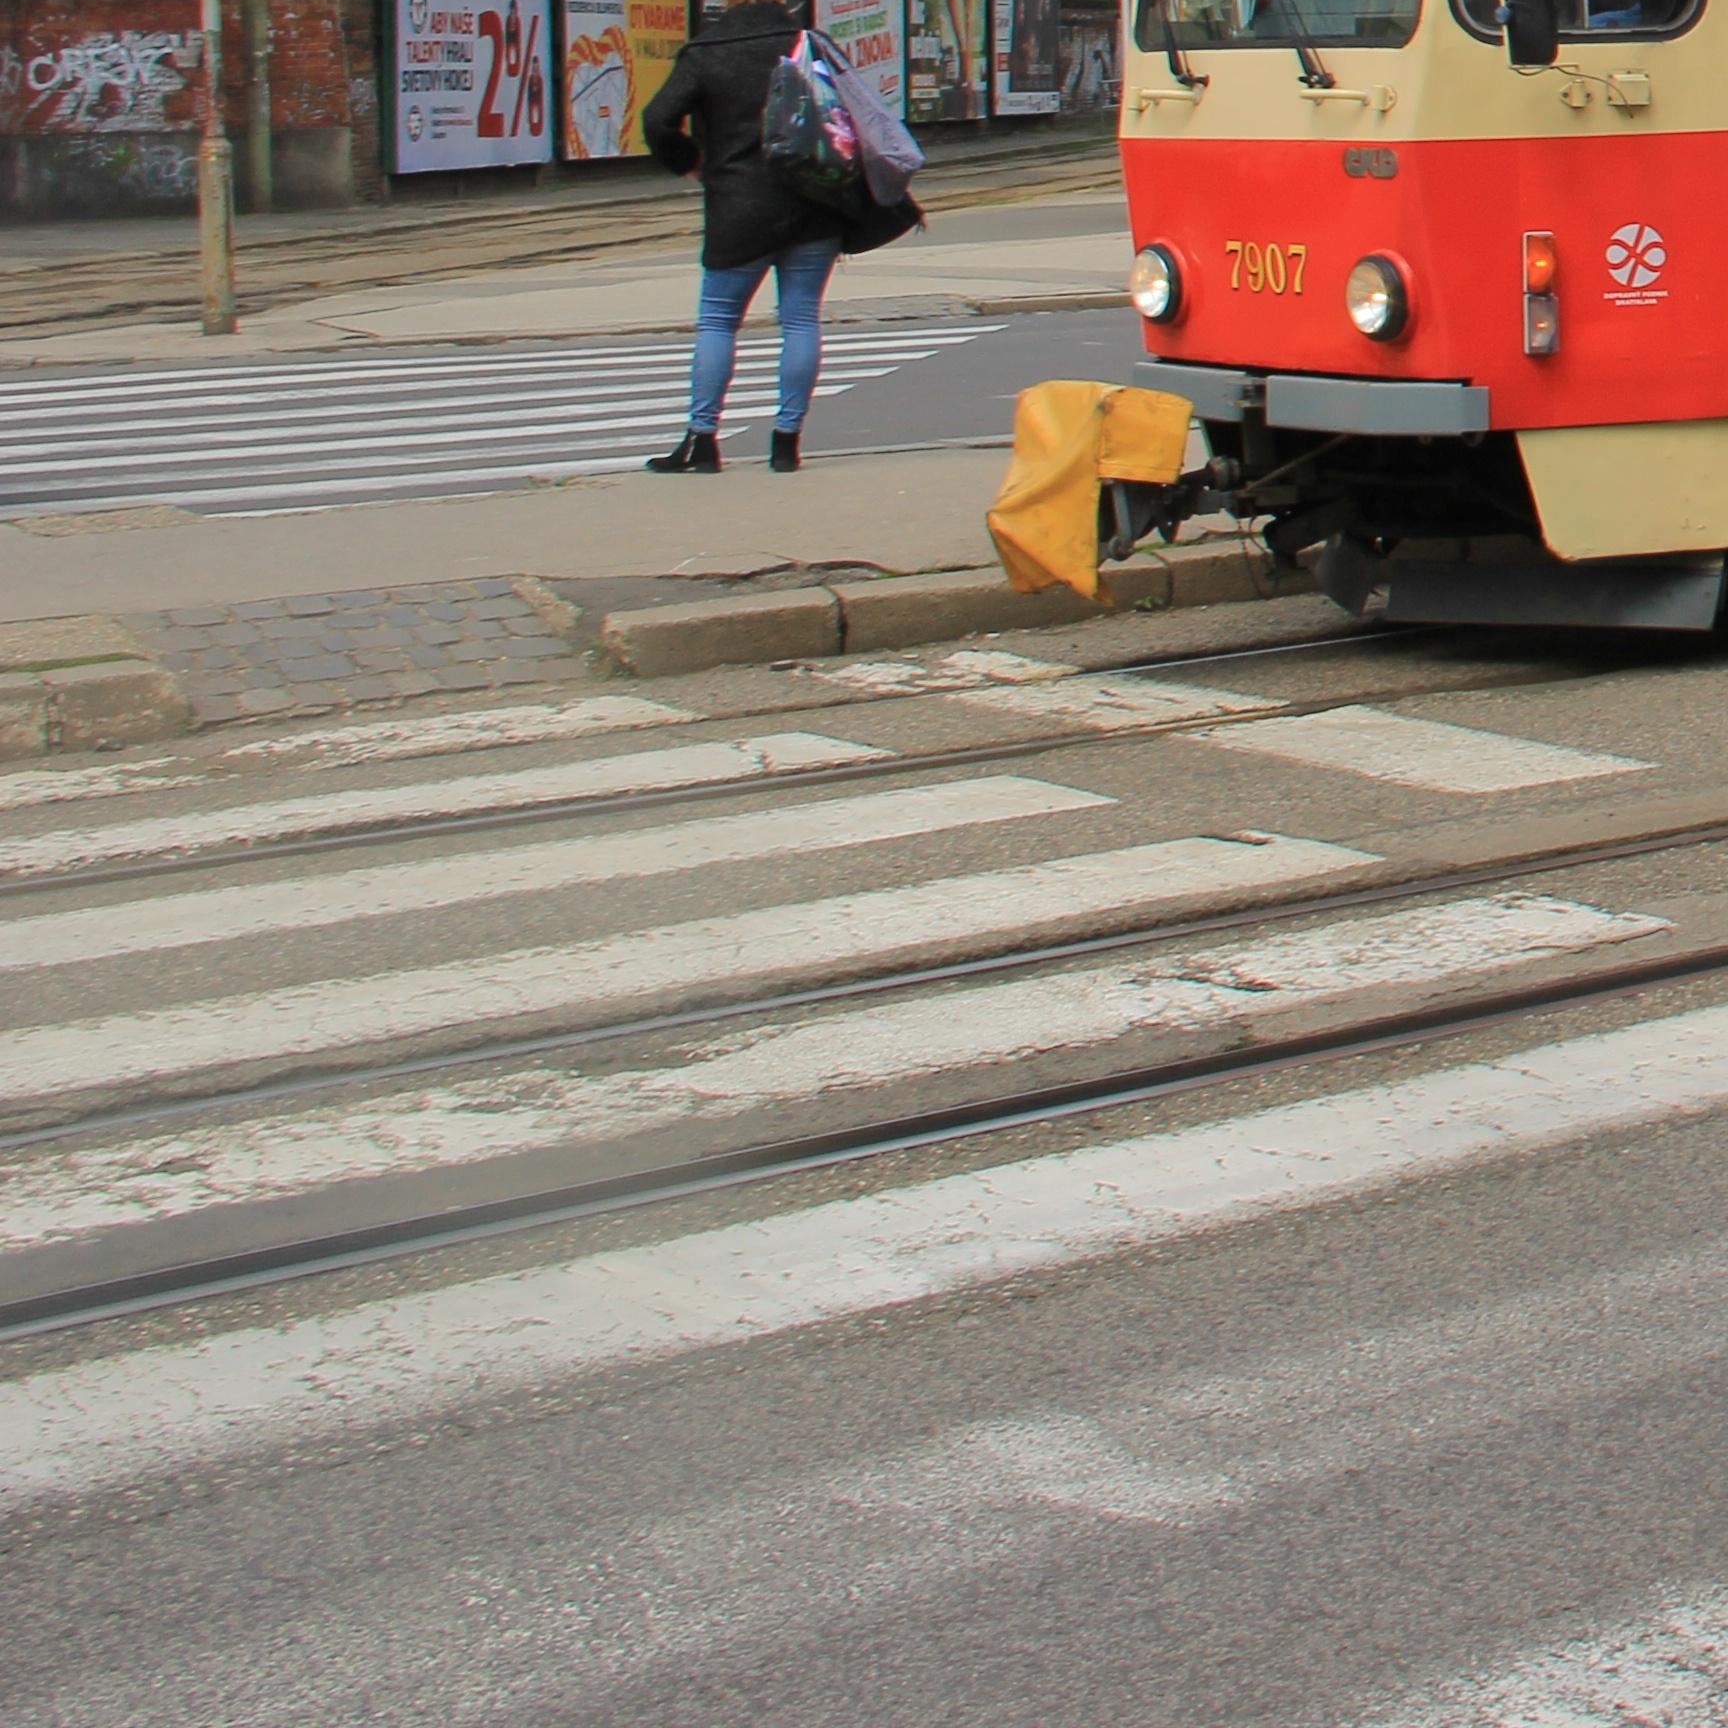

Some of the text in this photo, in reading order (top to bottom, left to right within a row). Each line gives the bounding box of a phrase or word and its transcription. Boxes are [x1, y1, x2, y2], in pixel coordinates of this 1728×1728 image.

[431, 6, 474, 35] ABY NAŠE
[1226, 240, 1307, 295] 7907
